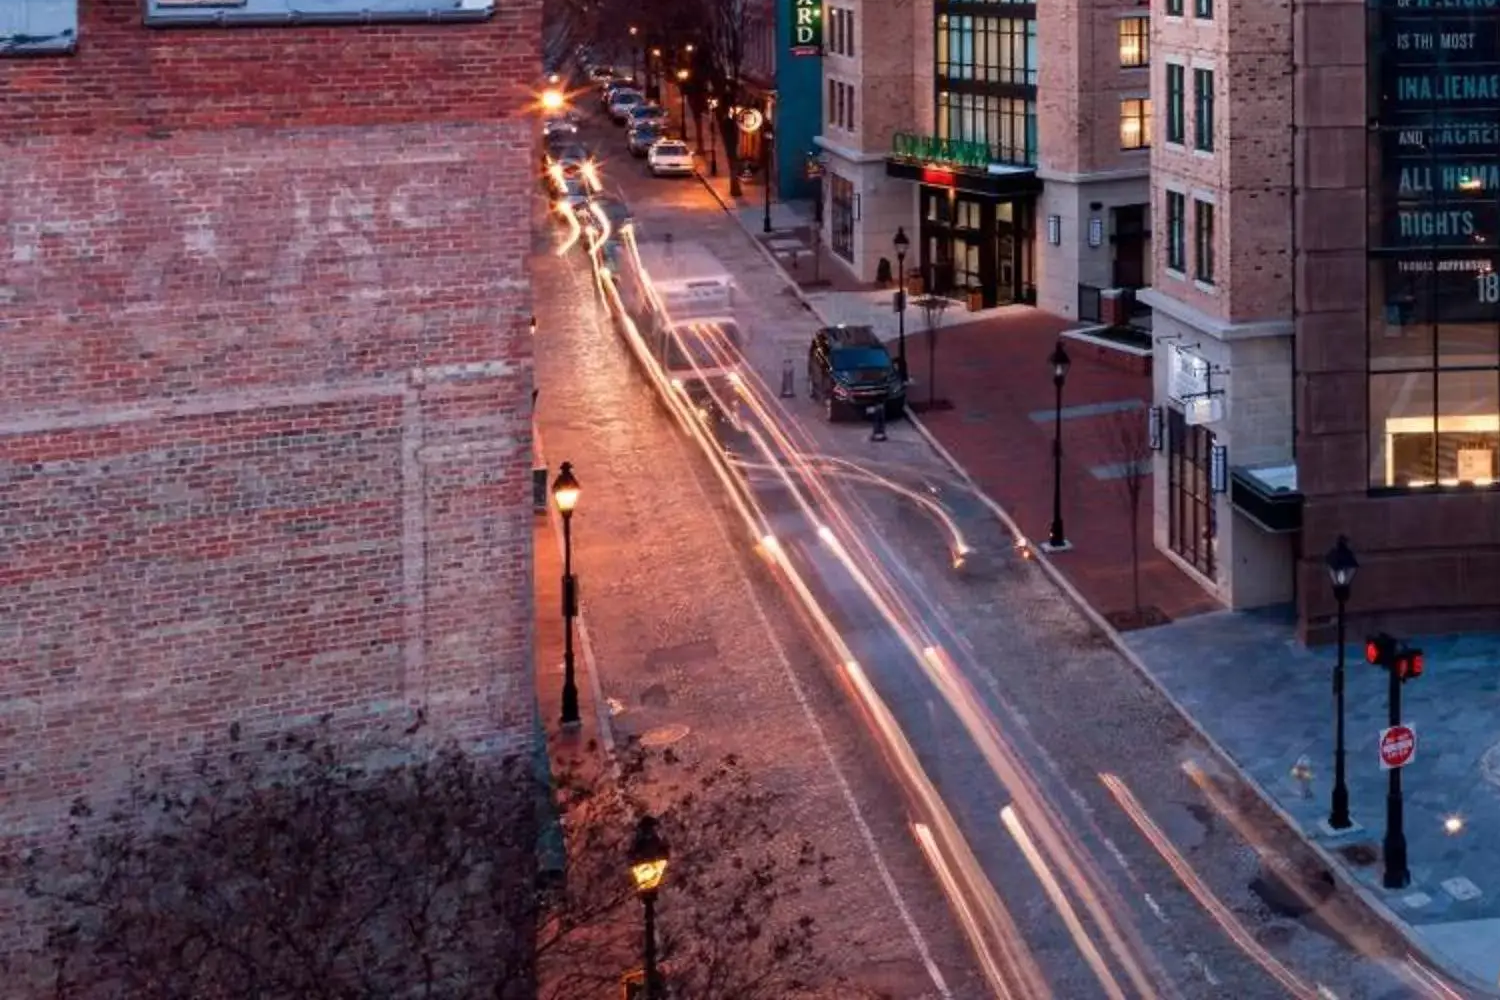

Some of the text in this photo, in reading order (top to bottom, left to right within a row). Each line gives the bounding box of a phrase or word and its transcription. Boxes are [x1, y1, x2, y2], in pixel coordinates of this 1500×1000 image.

[1397, 33, 1409, 50] IS
[1440, 32, 1477, 50] MOST
[1398, 130, 1423, 146] AND
[1398, 167, 1433, 193] ALL
[1398, 210, 1474, 238] RIGHTS
